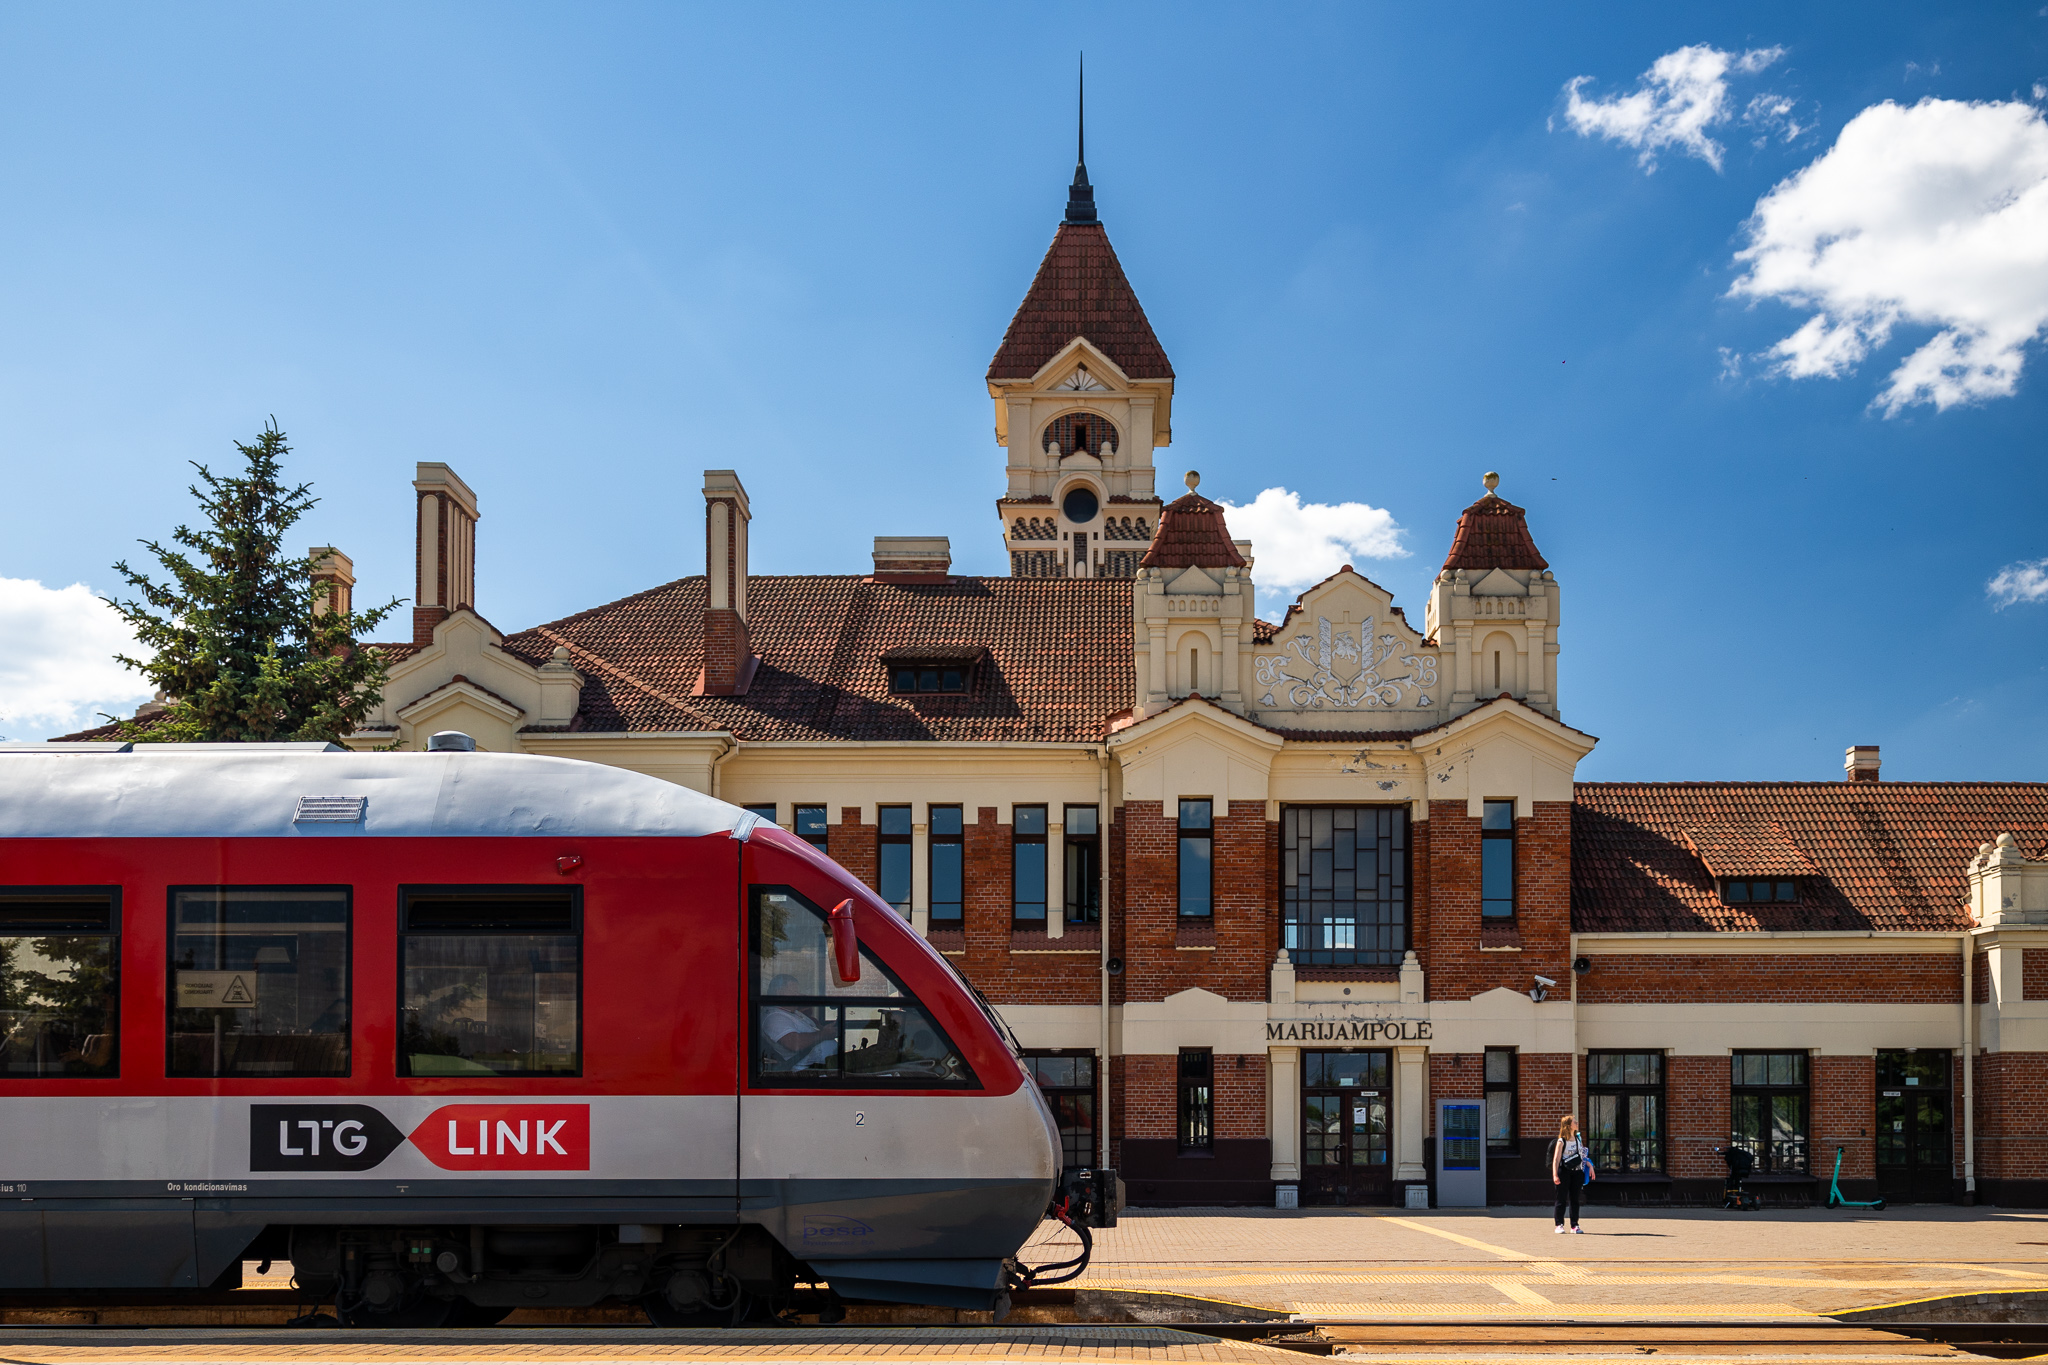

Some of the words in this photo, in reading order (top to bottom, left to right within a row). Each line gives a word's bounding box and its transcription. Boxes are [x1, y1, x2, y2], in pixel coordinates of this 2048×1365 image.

[1266, 1021, 1433, 1040] MARIJAMPOLĖ
[856, 1113, 864, 1125] 2
[279, 1120, 368, 1156] LTG
[448, 1120, 568, 1155] LINK
[0, 1184, 14, 1192] ius
[17, 1184, 27, 1192] 110
[167, 1183, 181, 1191] Oro
[184, 1183, 248, 1191] kondicionavimas
[803, 1227, 866, 1239] pesa
